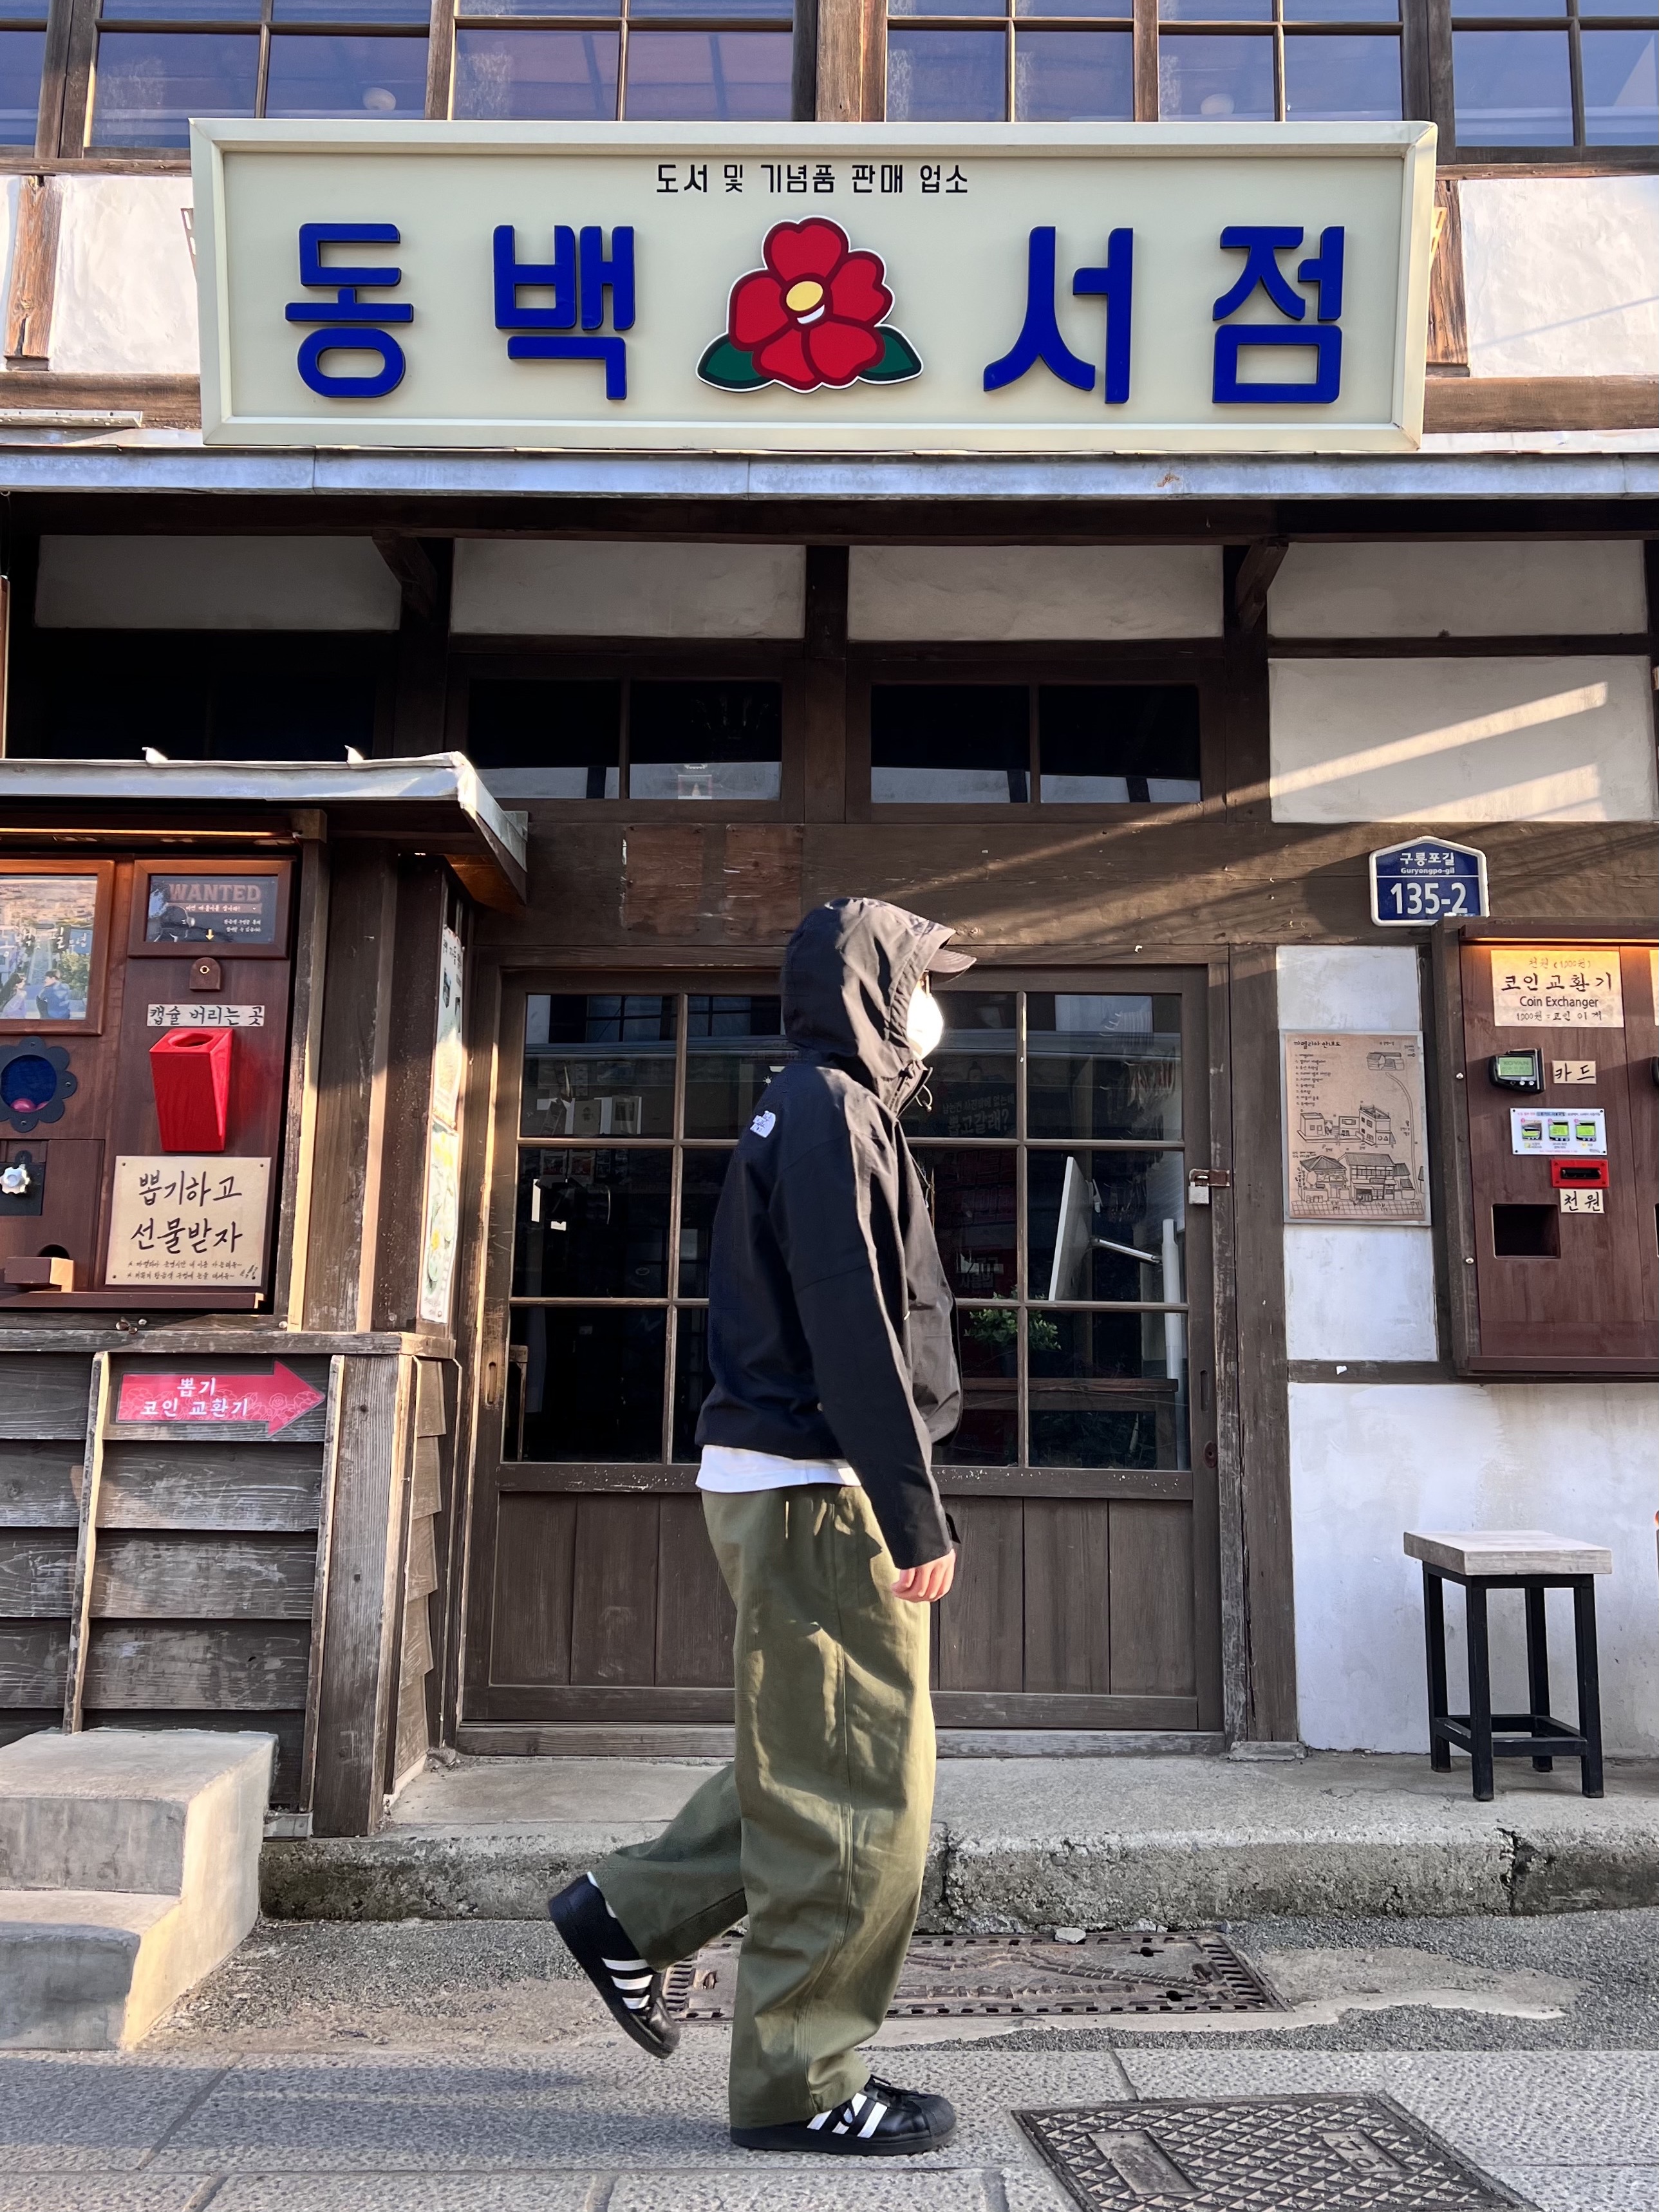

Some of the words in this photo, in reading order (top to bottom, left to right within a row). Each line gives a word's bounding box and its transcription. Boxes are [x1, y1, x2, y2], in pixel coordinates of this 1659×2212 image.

[656, 164, 708, 193] 도서
[724, 164, 744, 193] 및
[760, 164, 835, 193] 기념품
[852, 164, 903, 193] 판매
[920, 164, 968, 193] 업소
[1400, 852, 1455, 867] 구룡포길
[1400, 867, 1455, 876] Guryongpo-gil
[169, 883, 261, 902] WANTED
[1390, 882, 1468, 915] 135-2
[1519, 995, 1543, 1008] Coin
[1545, 996, 1599, 1009] Exchanger
[149, 1005, 182, 1026] 캡슐
[189, 1006, 241, 1025] 버리는
[247, 1006, 265, 1026] 곳
[1554, 1062, 1595, 1082] 카드
[138, 1169, 243, 1207] 뽑기하고
[1563, 1190, 1601, 1212] 천원
[129, 1217, 243, 1255] 선물받자
[176, 1376, 217, 1398] 뽑기
[140, 1398, 178, 1416] 코인
[188, 1398, 248, 1418] 교환기
